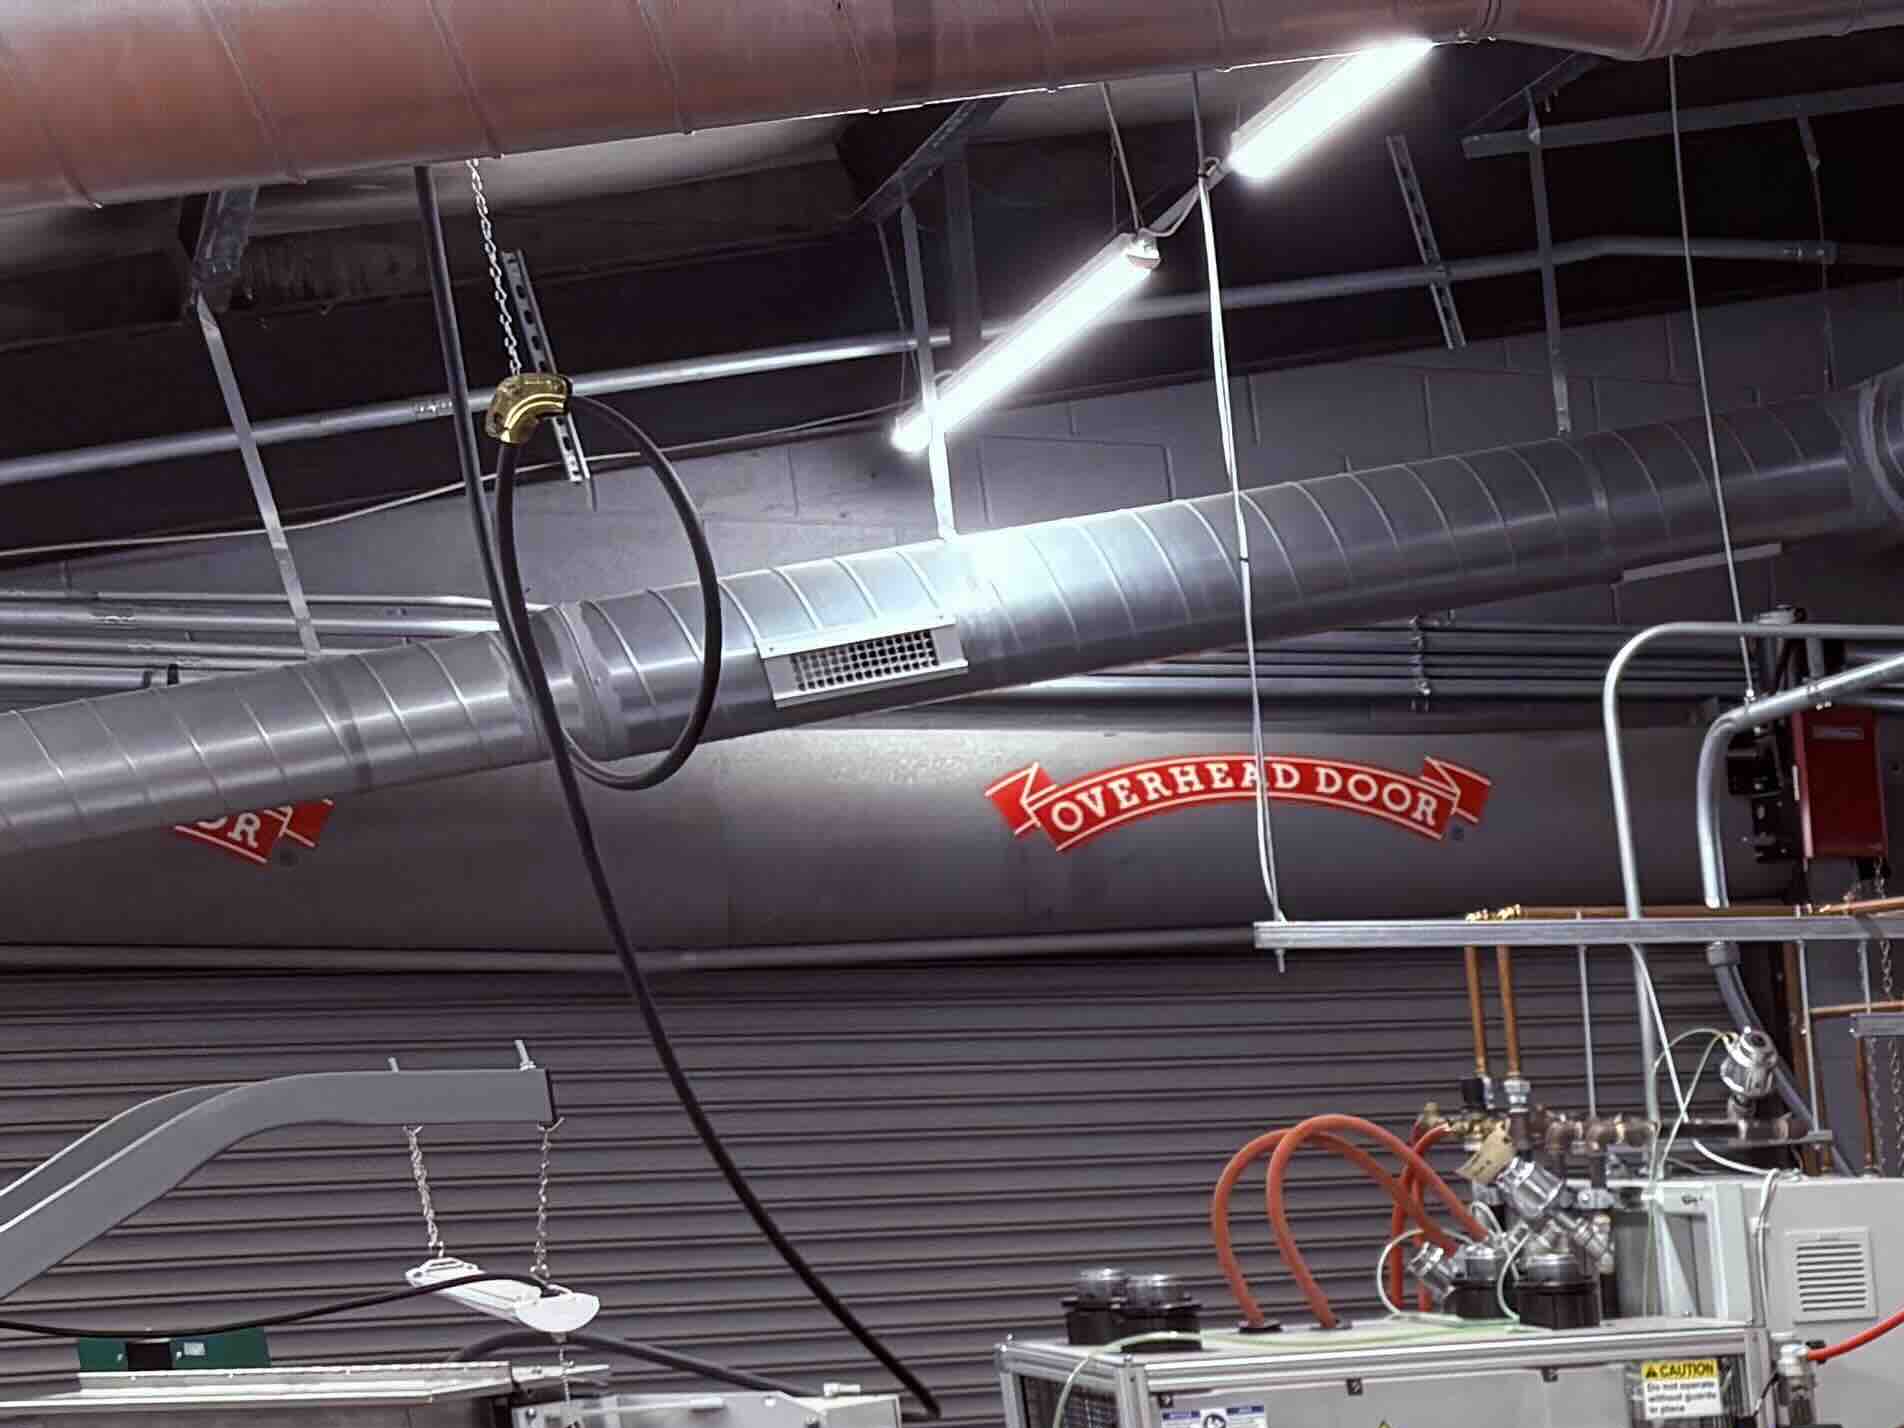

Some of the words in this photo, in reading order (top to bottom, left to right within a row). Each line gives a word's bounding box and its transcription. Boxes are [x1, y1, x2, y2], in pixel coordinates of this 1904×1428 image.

[1052, 761, 1300, 833] OVERHEAD
[1316, 765, 1439, 826] DOOR
[1659, 1361, 1715, 1377] CAUTION
